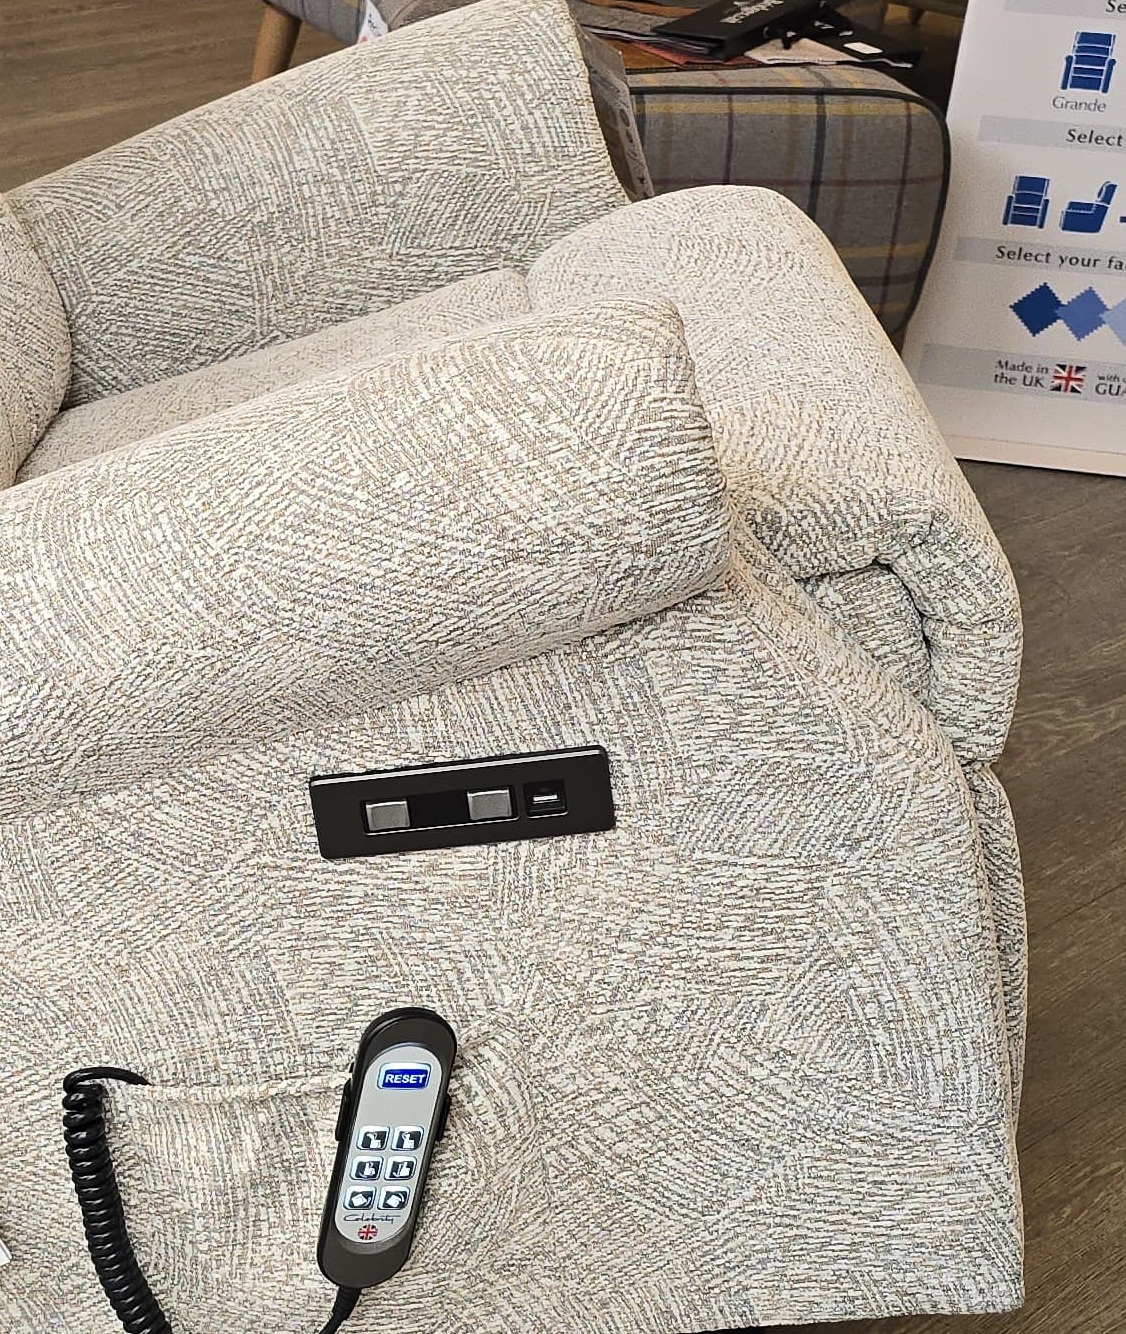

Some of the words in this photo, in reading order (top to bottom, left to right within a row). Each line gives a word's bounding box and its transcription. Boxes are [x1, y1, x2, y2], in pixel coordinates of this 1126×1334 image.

[1052, 96, 1107, 114] Grande
[1065, 129, 1123, 147] Select
[995, 246, 1053, 264] Select
[1059, 253, 1100, 268] your
[1108, 257, 1126, 271] fa
[995, 359, 1033, 373] Made
[1037, 364, 1049, 374] in
[994, 373, 1017, 385] the
[1022, 376, 1045, 387] UK
[1098, 374, 1120, 382] with
[384, 1073, 426, 1085] RESET
[342, 1213, 401, 1224] Celebrity
